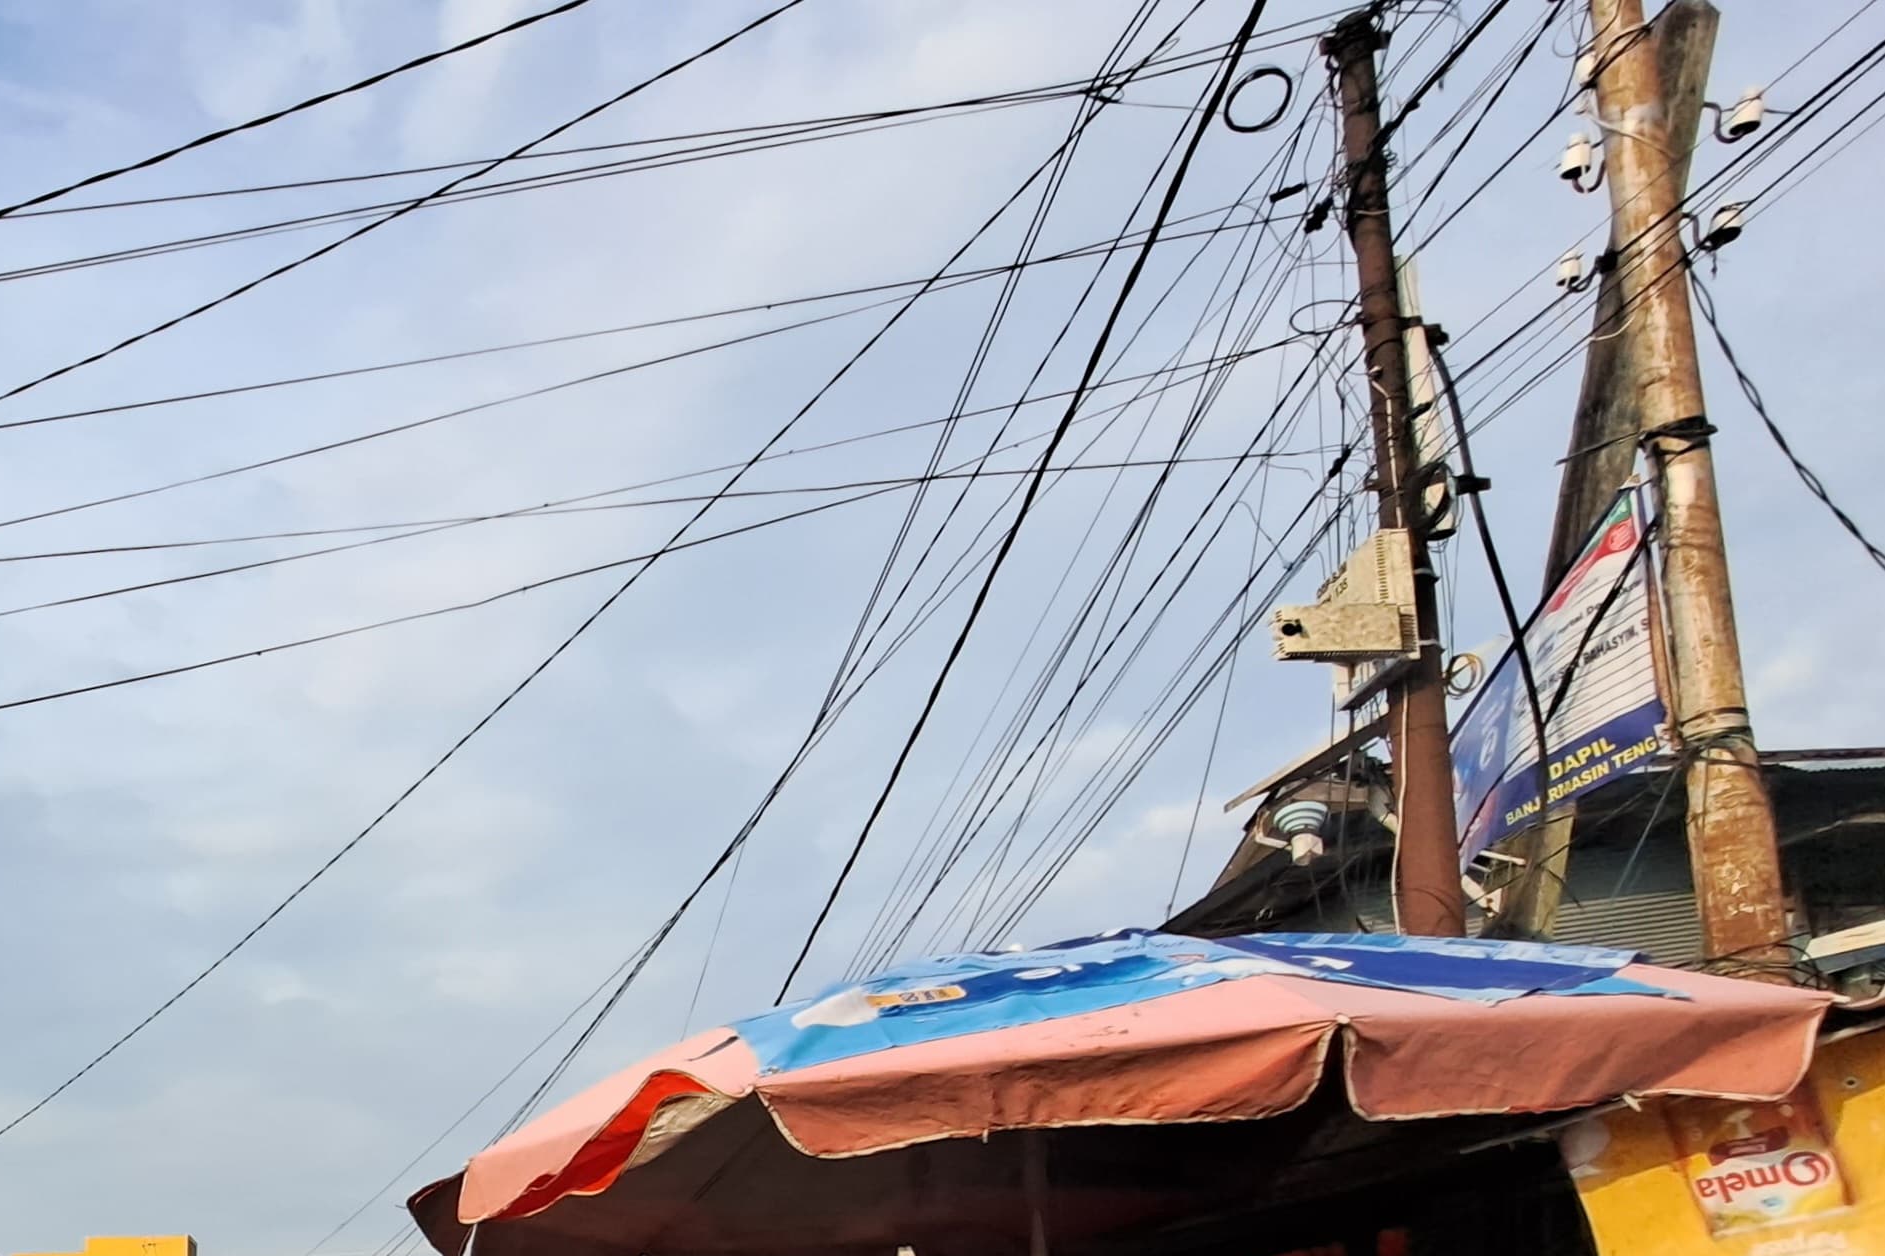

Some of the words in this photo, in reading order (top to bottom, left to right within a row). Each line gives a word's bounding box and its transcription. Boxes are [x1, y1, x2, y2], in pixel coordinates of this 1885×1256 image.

[1549, 737, 1616, 781] DAPIL
[1505, 761, 1610, 826] BANJRMASIN
[1695, 1151, 1832, 1204] Omela
